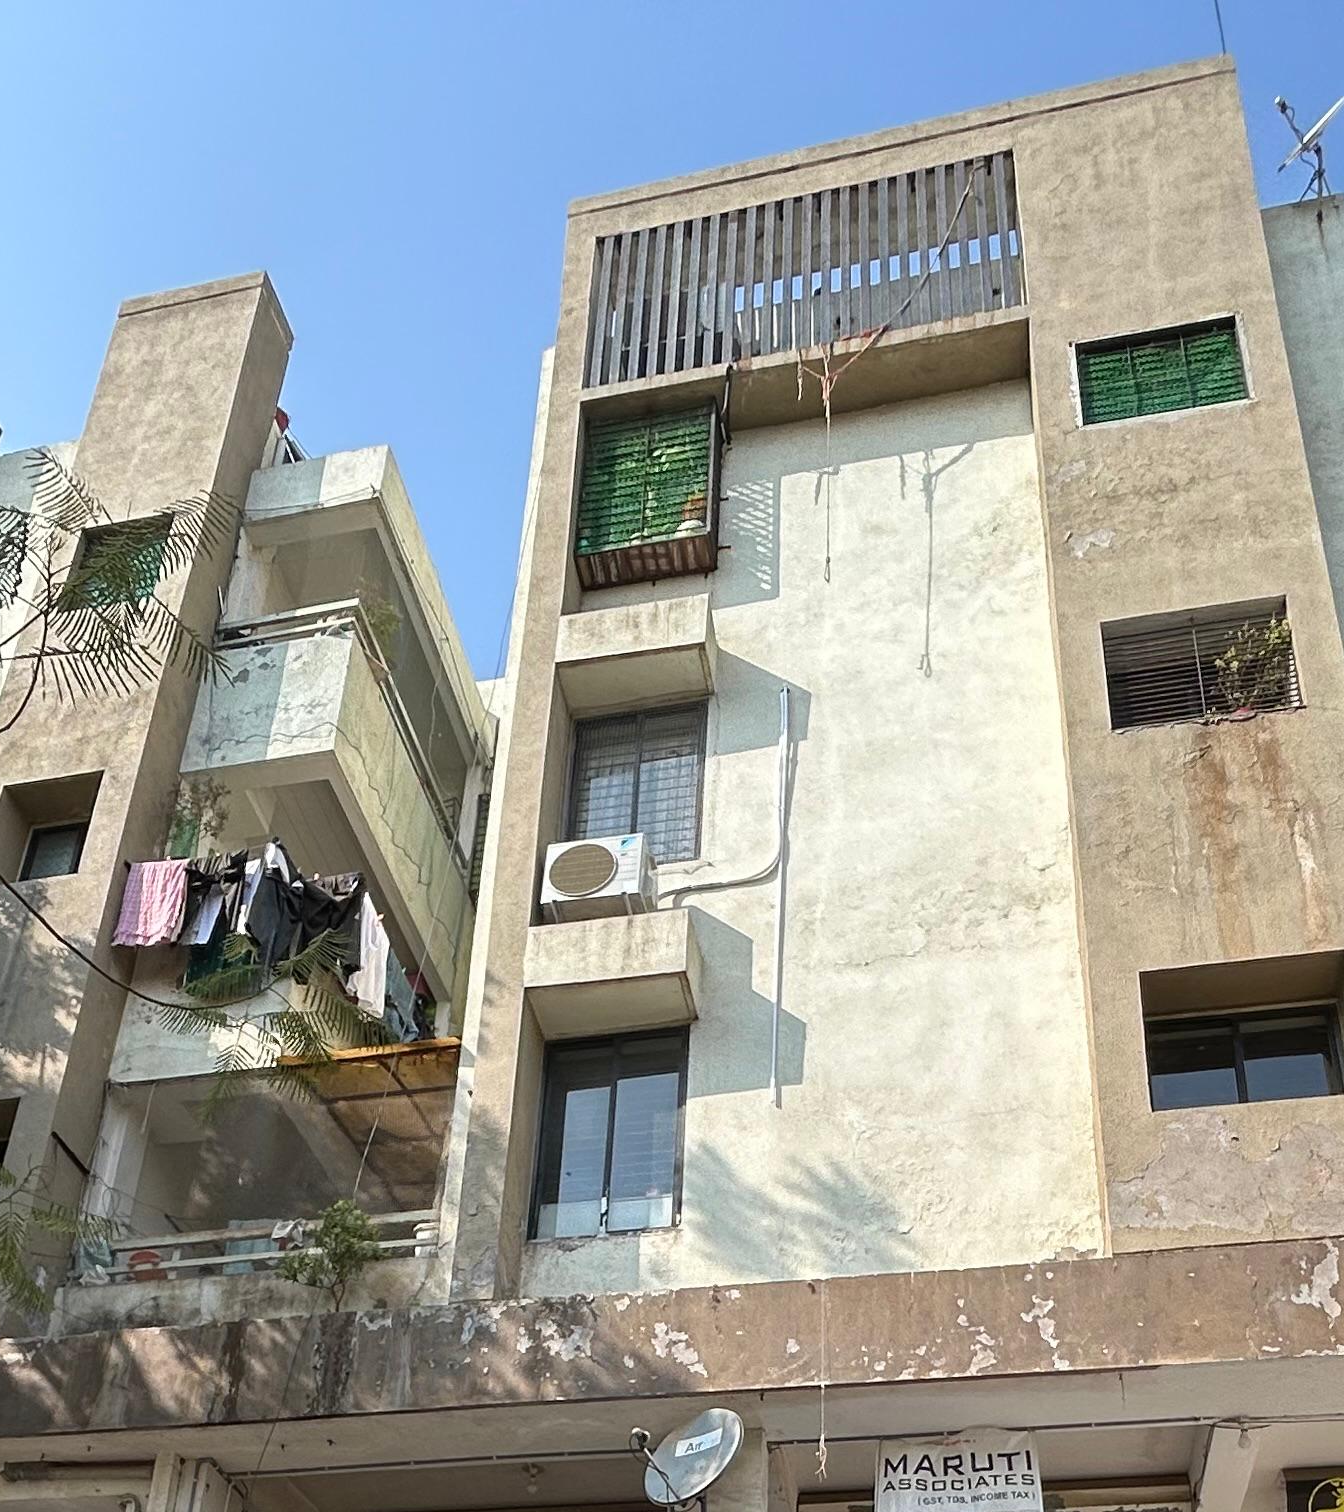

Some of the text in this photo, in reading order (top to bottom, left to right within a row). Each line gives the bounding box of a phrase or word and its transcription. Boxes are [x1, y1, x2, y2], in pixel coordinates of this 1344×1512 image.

[884, 1450, 1032, 1478] MARUTI
[883, 1474, 1035, 1493] ASSOCIATES
[970, 1492, 1008, 1504] INCOME
